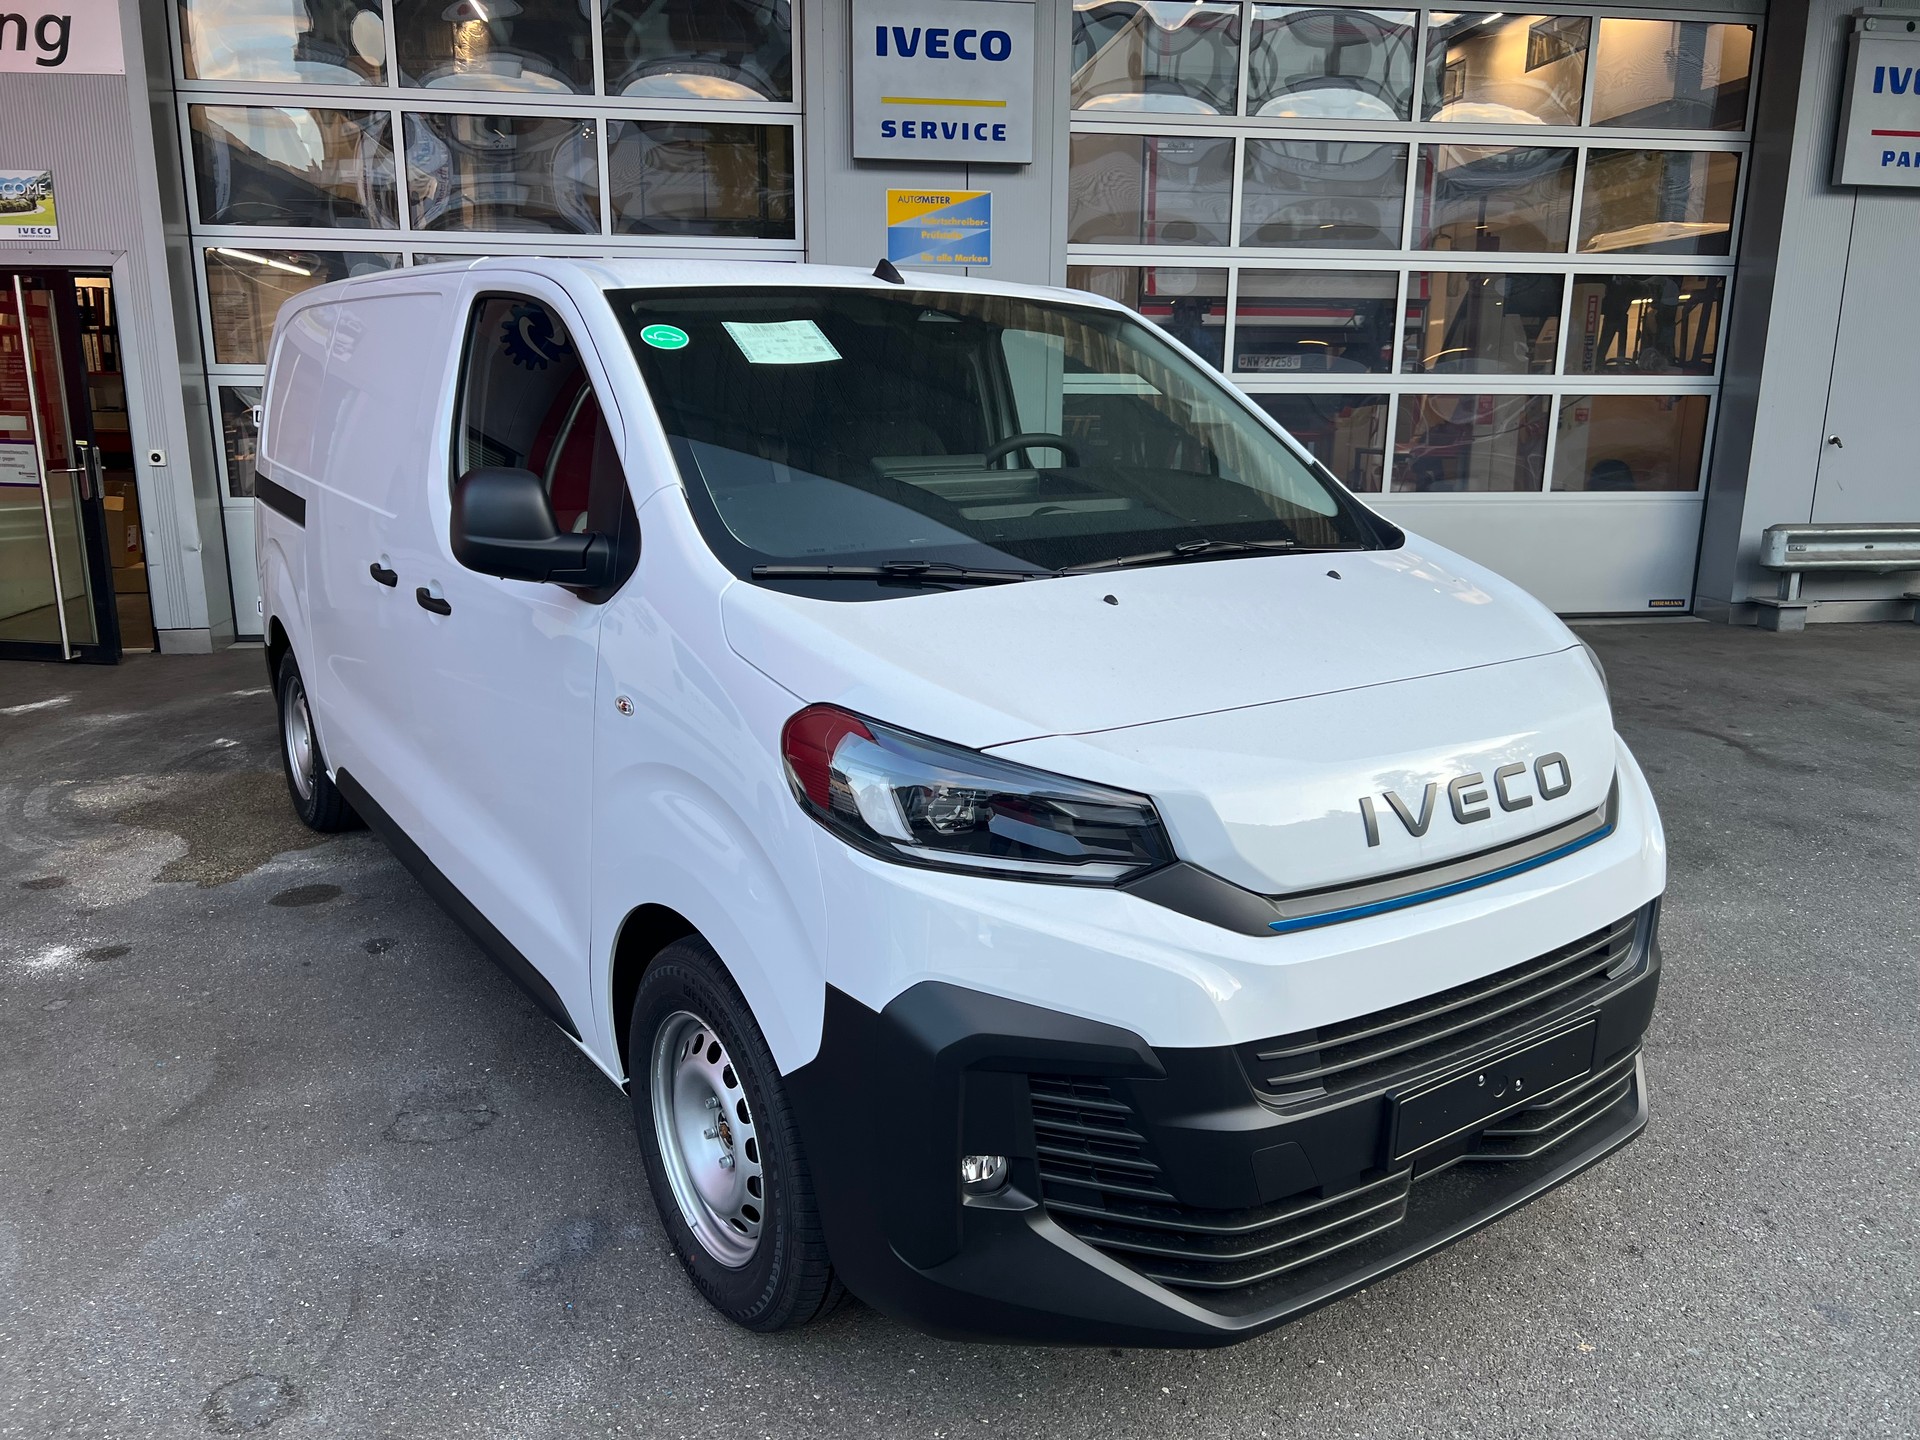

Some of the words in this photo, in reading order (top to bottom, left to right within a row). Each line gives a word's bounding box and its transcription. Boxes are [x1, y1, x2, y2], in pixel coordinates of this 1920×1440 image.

[0, 13, 71, 67] ng
[876, 26, 1012, 61] IVECO
[881, 120, 1007, 141] SERVICE
[0, 182, 46, 194] COME
[897, 195, 951, 204] AUTOMETER
[937, 254, 952, 262] alle
[955, 254, 988, 263] Marken
[1359, 752, 1572, 848] IVECO
